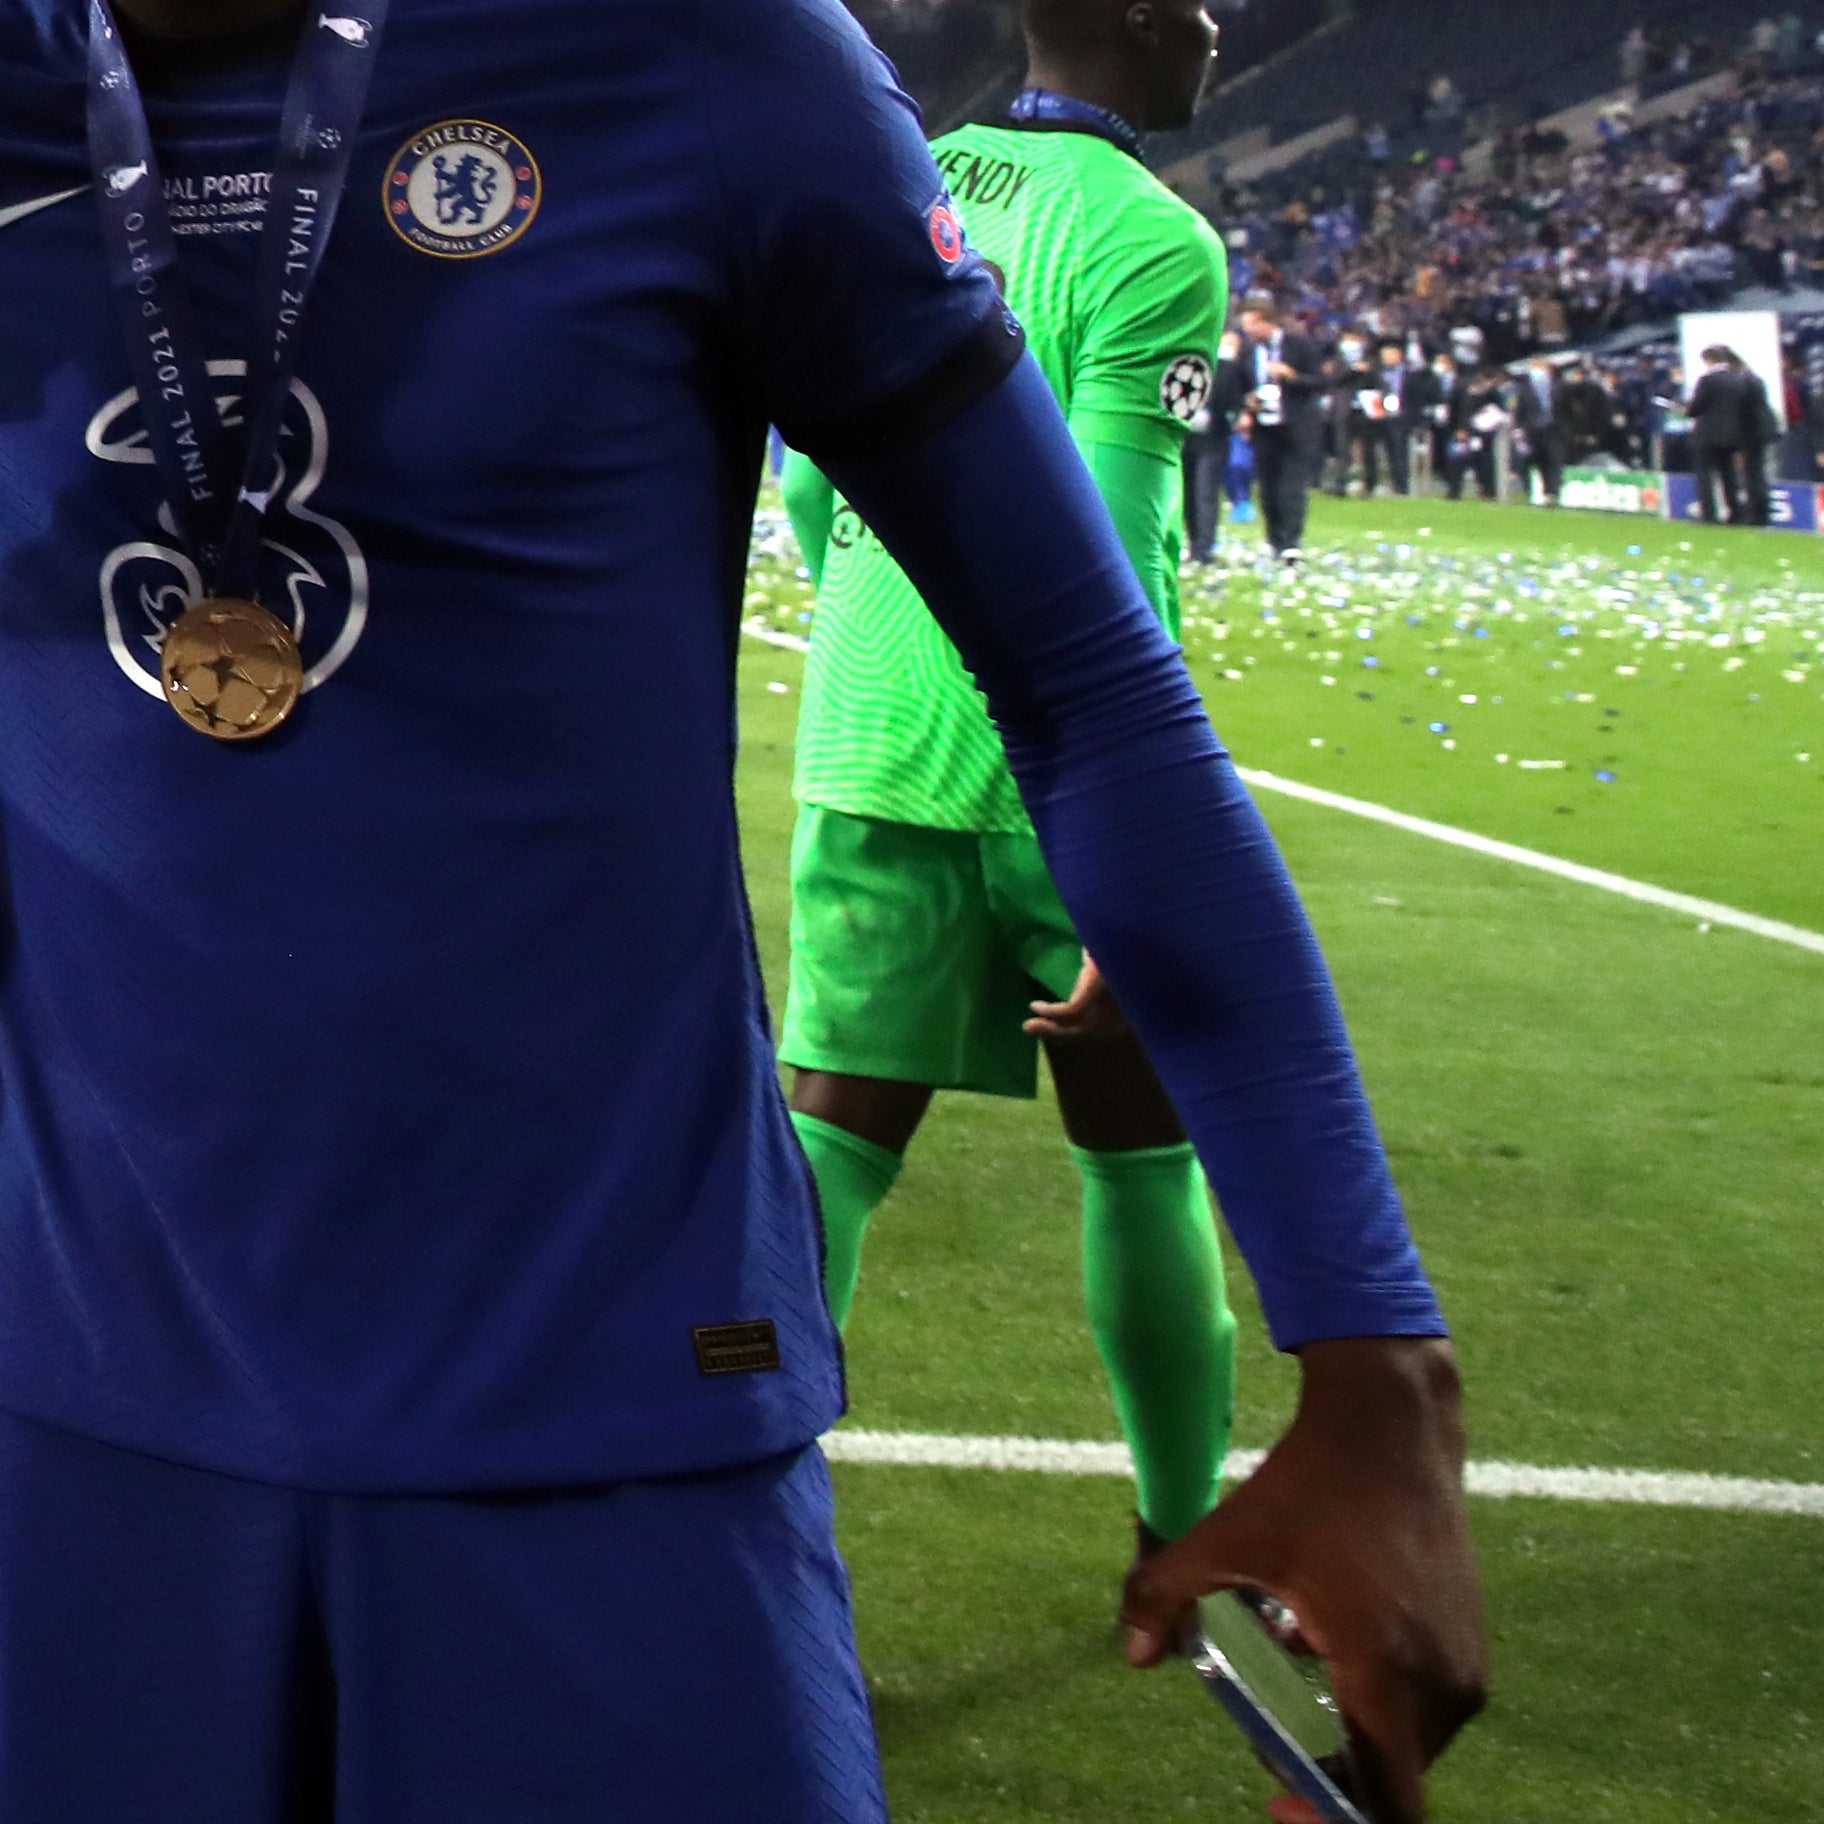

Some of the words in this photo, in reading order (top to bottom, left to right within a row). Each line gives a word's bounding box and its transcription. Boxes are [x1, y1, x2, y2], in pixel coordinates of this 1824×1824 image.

[412, 125, 511, 156] CHELSEA
[123, 211, 164, 318] PORTO
[284, 187, 319, 275] FINAL
[148, 326, 185, 403] 2021
[170, 408, 215, 501] FINAL
